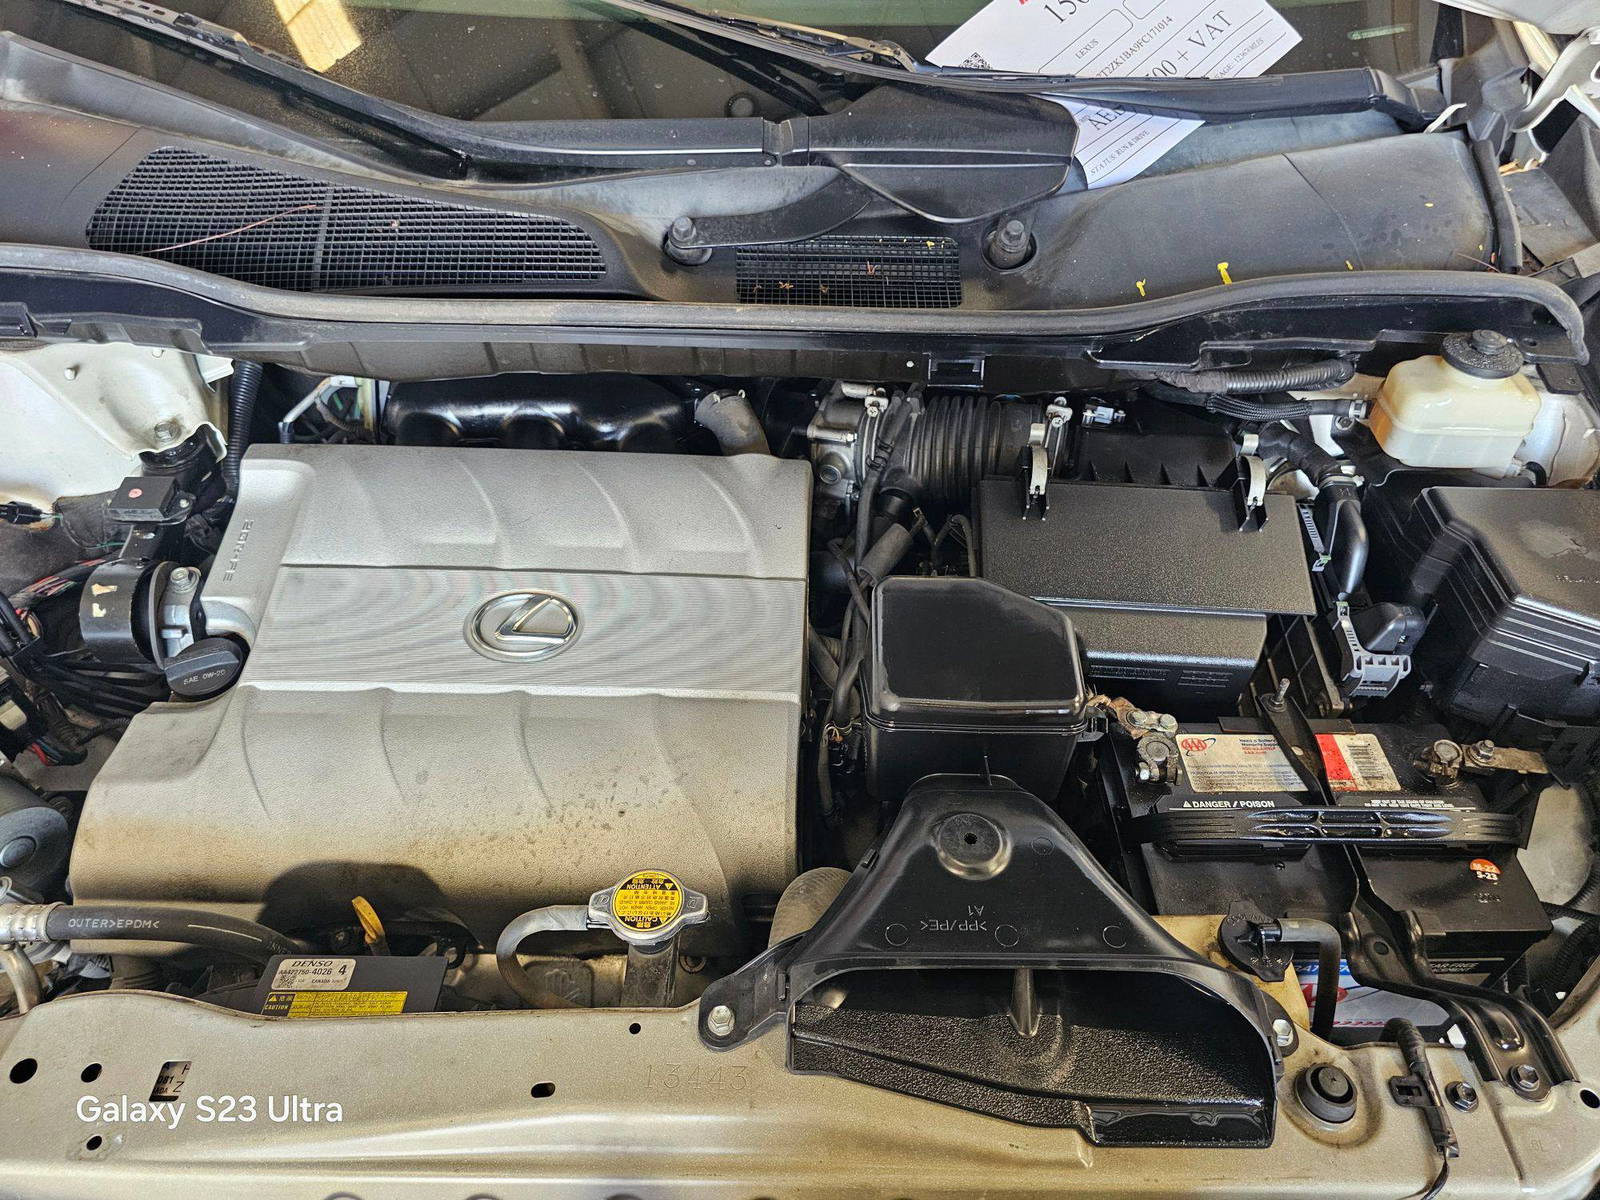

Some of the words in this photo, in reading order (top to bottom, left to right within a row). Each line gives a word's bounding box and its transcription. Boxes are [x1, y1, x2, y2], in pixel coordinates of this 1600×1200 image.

[1044, 0, 1091, 24] 15
[1075, 38, 1100, 60] LEXUS
[1088, 107, 1126, 131] AE
[1145, 59, 1178, 77] 00
[1188, 10, 1232, 48] VAT
[223, 519, 254, 582] 2GR-FE
[183, 675, 199, 685] SAE
[1182, 738, 1207, 752] AAA
[1192, 800, 1231, 808] DANGER
[1240, 800, 1275, 808] POISON
[967, 905, 985, 917] A1
[67, 918, 160, 929] OUTER>EPDM<
[920, 919, 987, 931] >PP/PE<
[338, 964, 347, 976] 4
[643, 1063, 748, 1090] 13443
